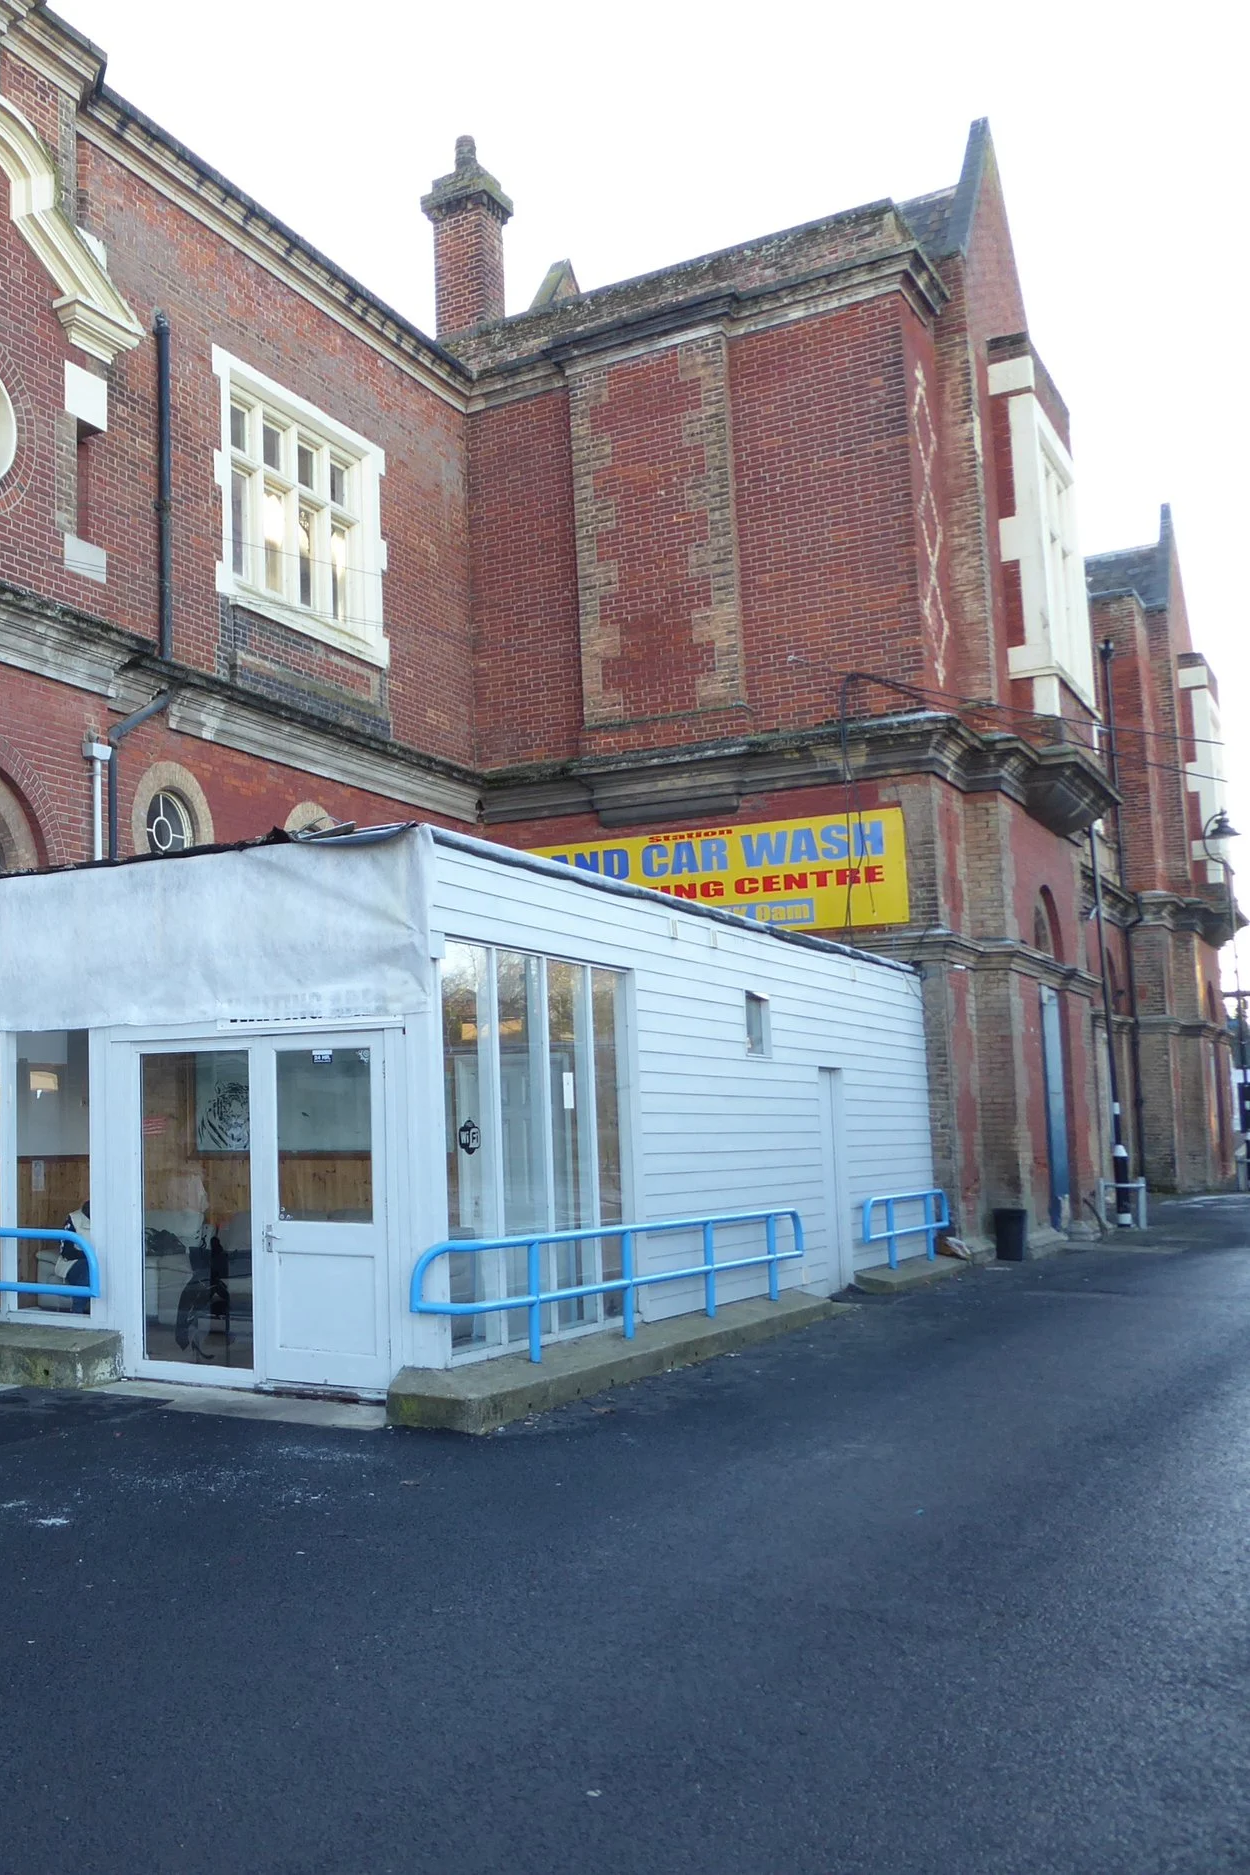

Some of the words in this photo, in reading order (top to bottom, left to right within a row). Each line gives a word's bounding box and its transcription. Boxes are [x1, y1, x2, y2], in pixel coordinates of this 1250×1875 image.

[642, 838, 728, 878] CAR
[740, 820, 885, 868] WASH
[648, 829, 733, 843] Station
[648, 881, 724, 899] ING
[734, 865, 885, 895] CENTRE
